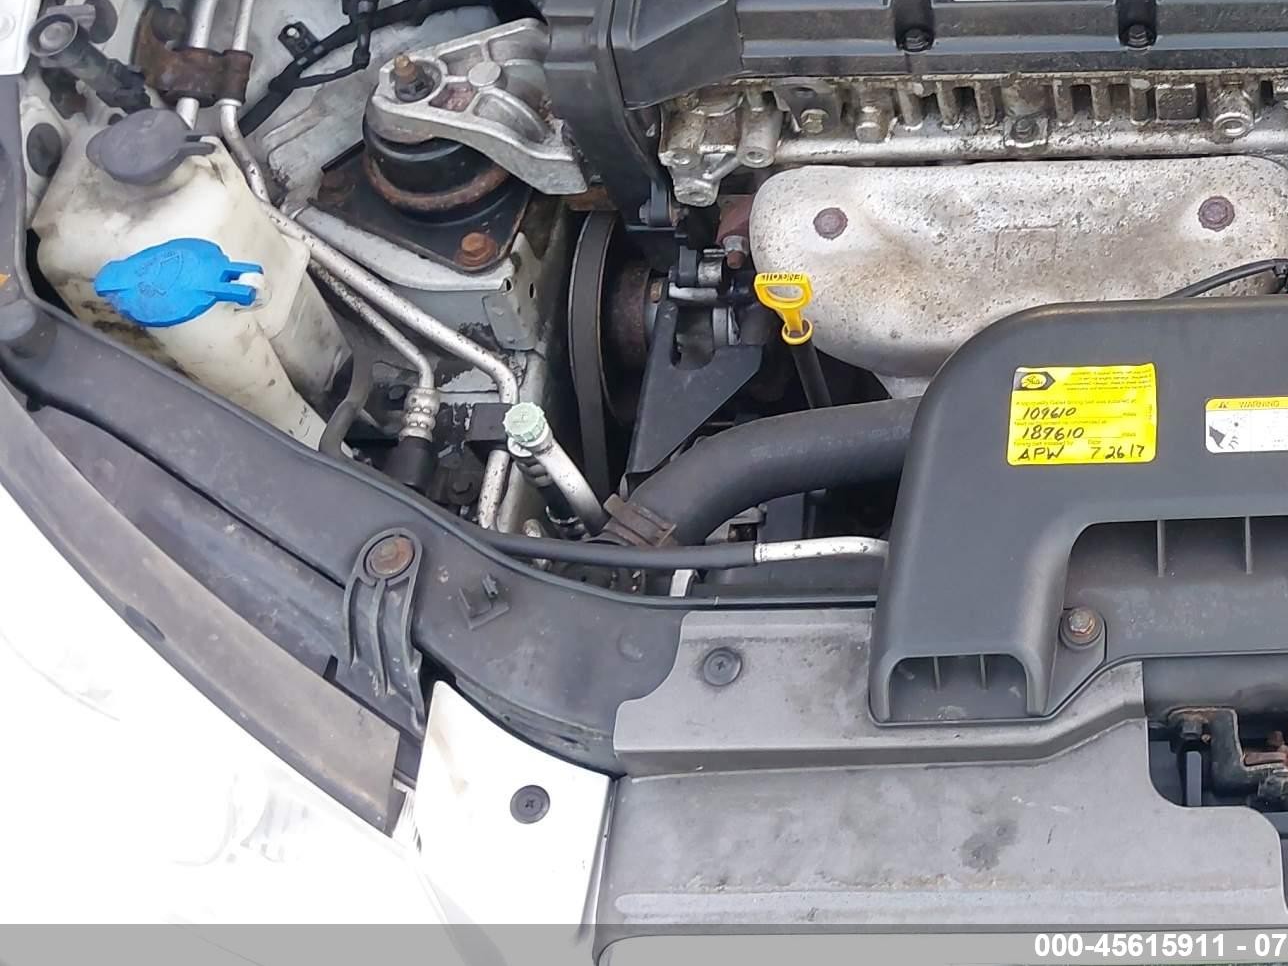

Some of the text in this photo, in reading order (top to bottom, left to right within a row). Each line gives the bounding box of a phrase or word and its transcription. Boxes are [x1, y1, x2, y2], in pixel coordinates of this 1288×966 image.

[1239, 400, 1280, 409] WARNING
[1022, 406, 1077, 420] 109610
[1021, 424, 1085, 441] 189610
[1018, 445, 1064, 460] APW
